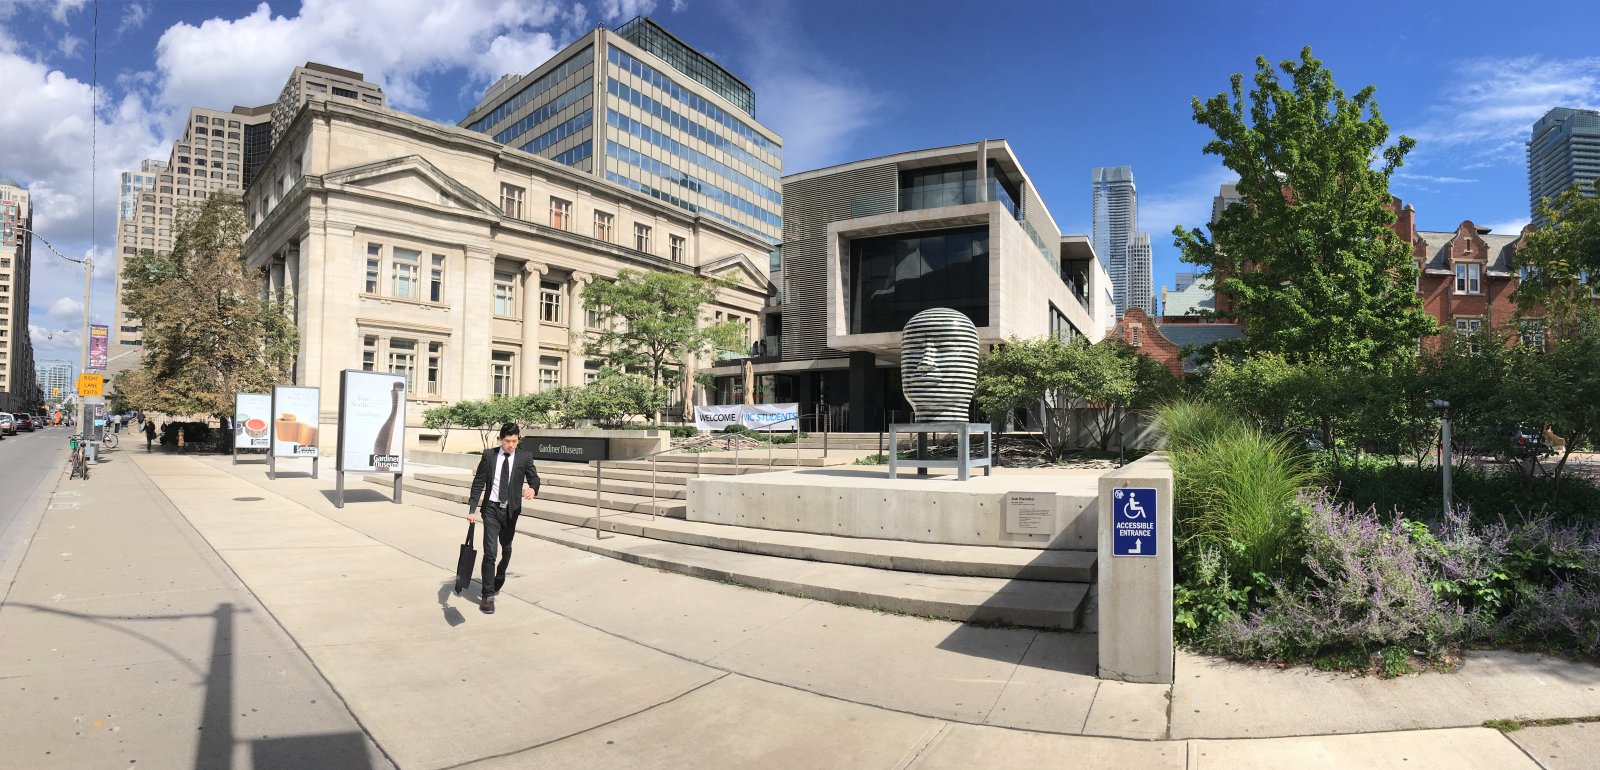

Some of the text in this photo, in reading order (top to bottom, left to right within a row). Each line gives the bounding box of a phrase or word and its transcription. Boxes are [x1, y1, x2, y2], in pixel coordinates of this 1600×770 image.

[700, 413, 736, 422] WELCOME
[757, 412, 797, 421] STUDENTS
[539, 444, 583, 454] Gardiner Museum
[374, 454, 399, 462] Gardiner
